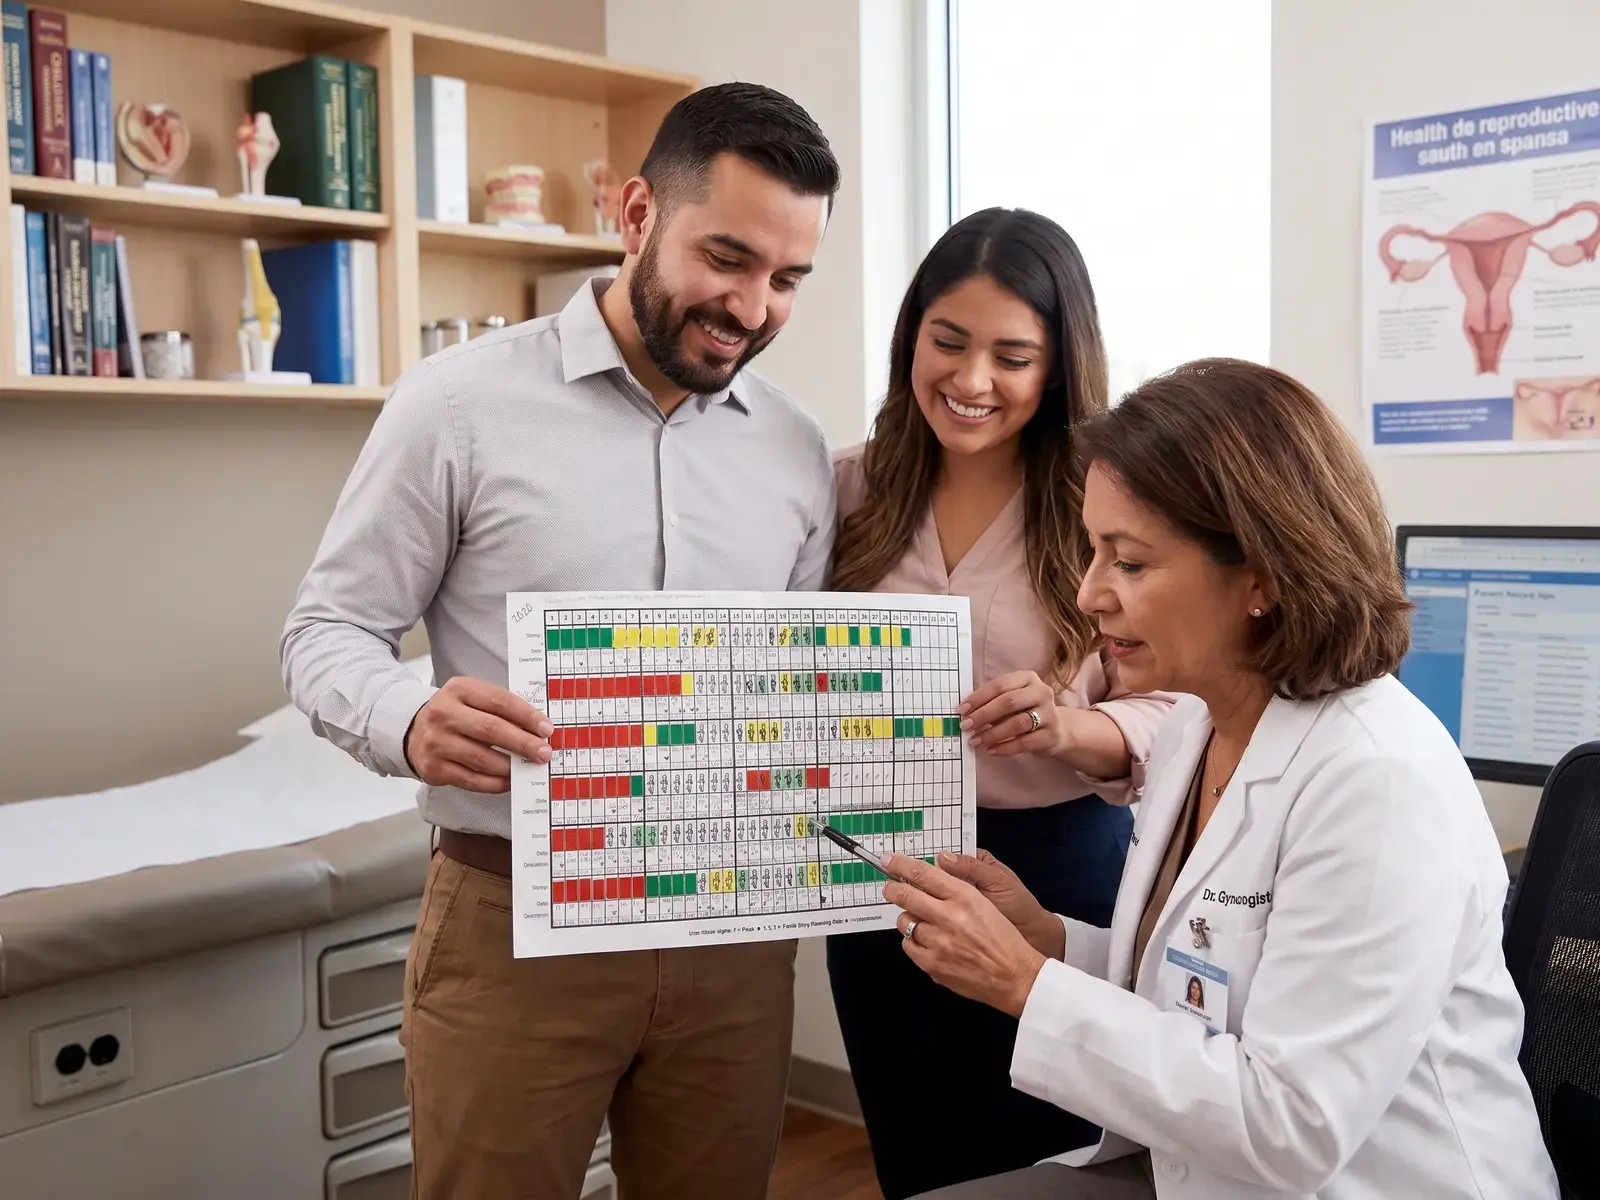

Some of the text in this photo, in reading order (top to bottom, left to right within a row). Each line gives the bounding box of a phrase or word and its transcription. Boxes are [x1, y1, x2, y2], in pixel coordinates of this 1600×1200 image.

[1390, 121, 1448, 148] Health
[1479, 101, 1599, 136] reproductive
[1472, 140, 1495, 158] en
[1500, 129, 1570, 156] spansa
[1202, 888, 1216, 902] Dr.
